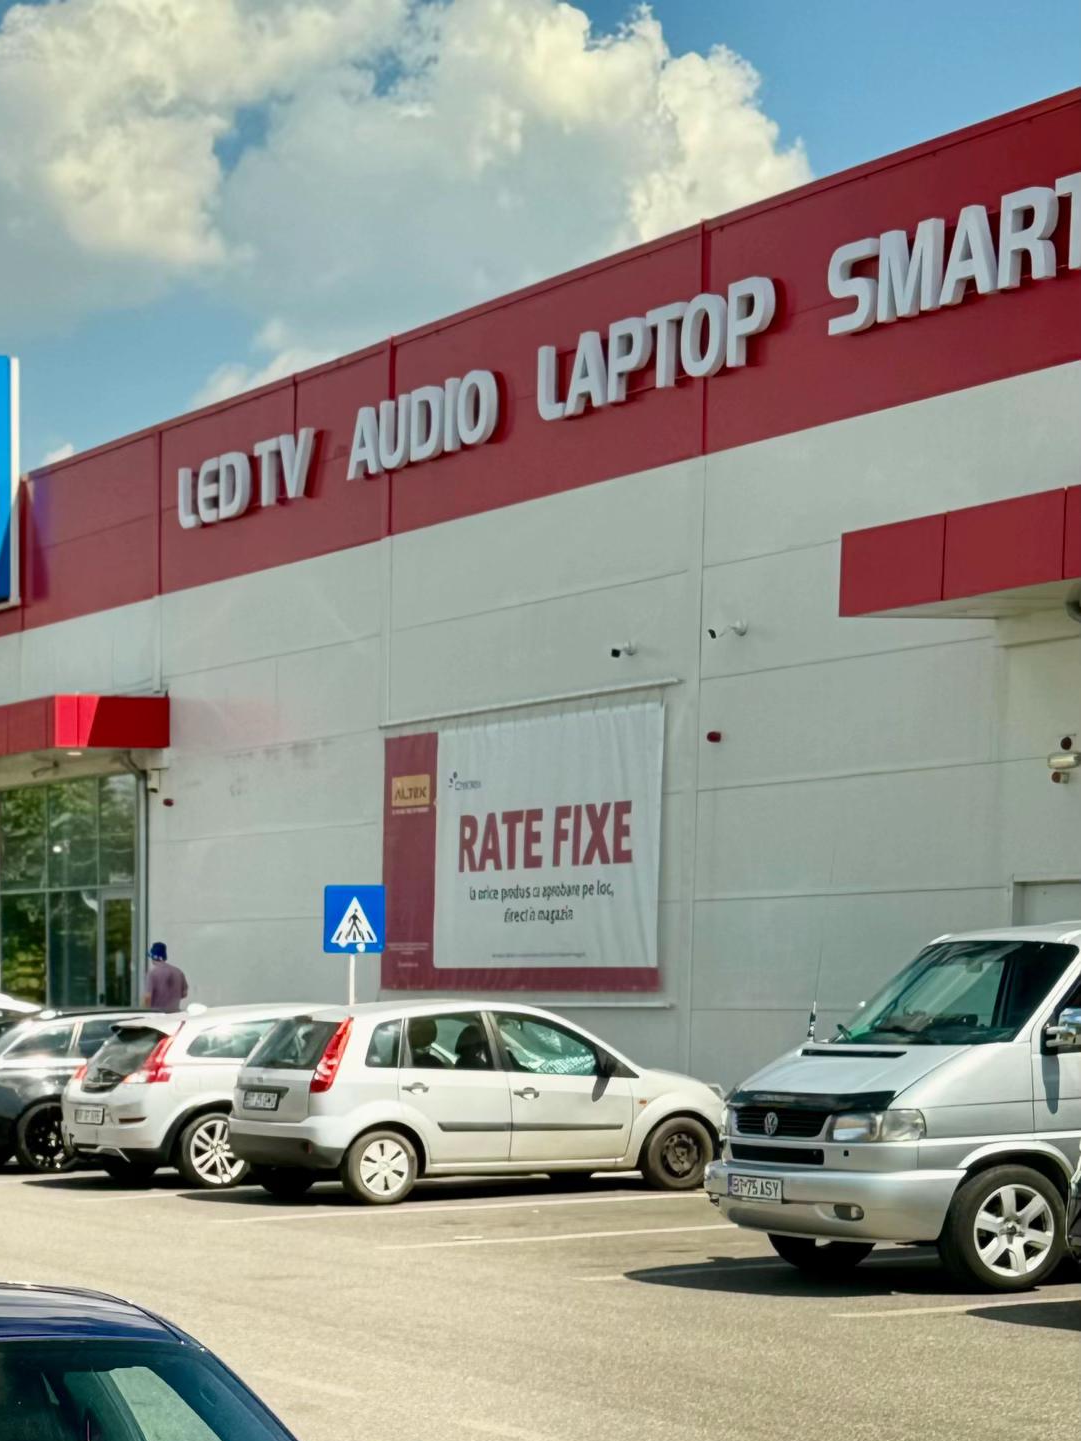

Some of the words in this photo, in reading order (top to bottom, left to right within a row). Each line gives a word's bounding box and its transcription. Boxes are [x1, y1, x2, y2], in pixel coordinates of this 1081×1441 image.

[178, 451, 252, 529] LED
[254, 427, 315, 507] TV
[346, 370, 499, 481] AUDIO
[537, 276, 776, 421] LAPTOP
[395, 786, 427, 801] ALTEX
[458, 808, 544, 873] RATE
[552, 800, 633, 867] FIXE
[478, 885, 499, 900] orice
[501, 885, 531, 903] produs
[542, 882, 581, 901] aprobare
[582, 883, 595, 899] pe
[596, 880, 615, 897] loc,
[503, 907, 528, 923] direct
[537, 905, 574, 924] magazin
